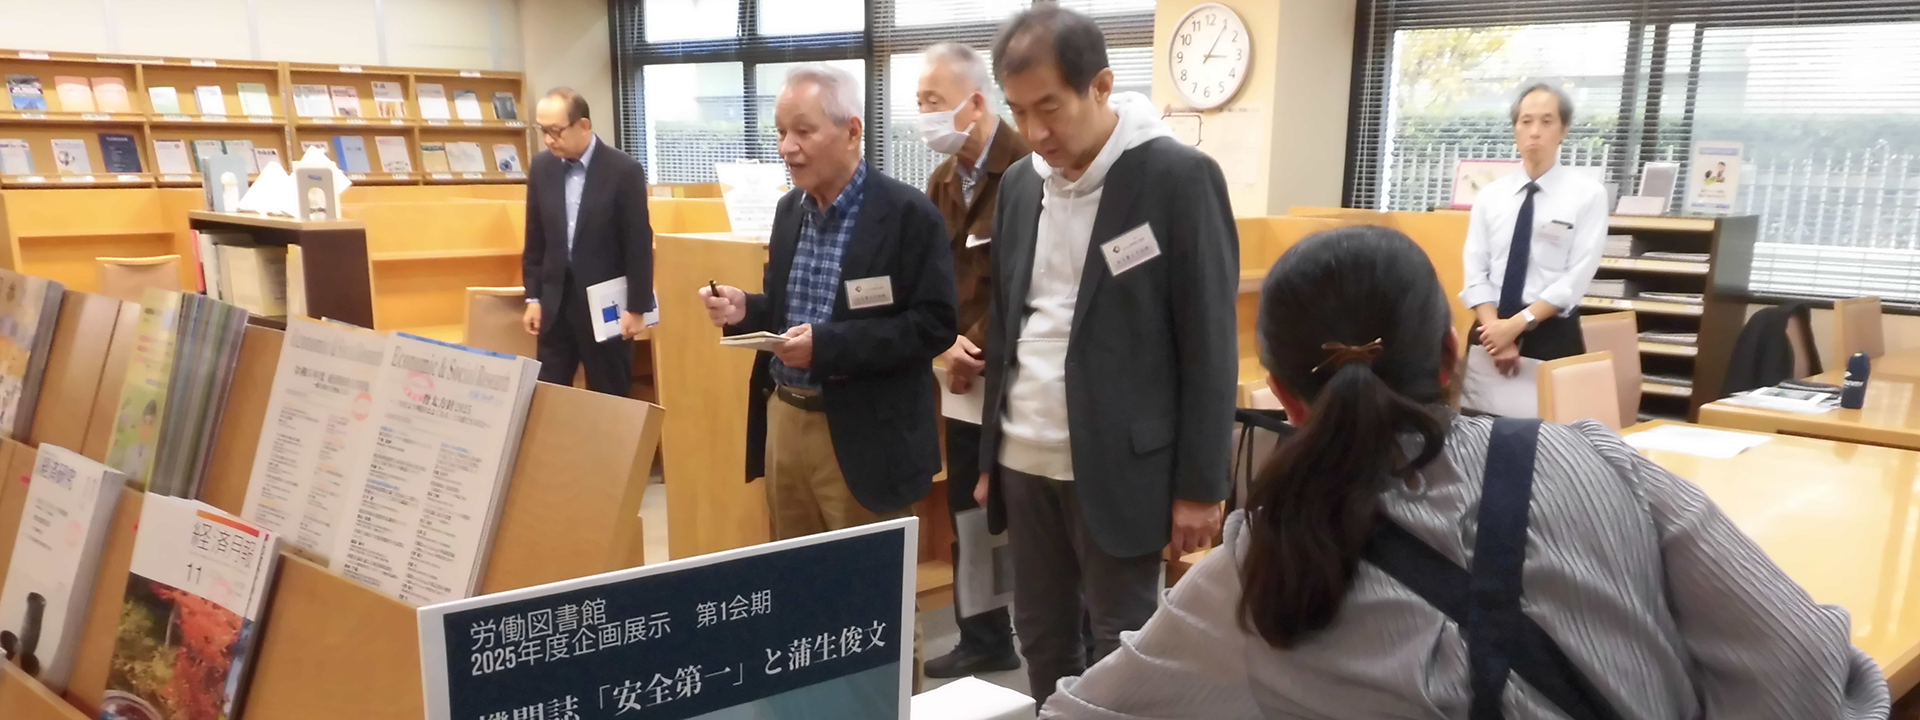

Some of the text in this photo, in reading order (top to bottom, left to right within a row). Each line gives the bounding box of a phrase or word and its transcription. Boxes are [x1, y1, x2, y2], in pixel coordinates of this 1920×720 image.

[1192, 20, 1201, 32] 11
[1205, 13, 1217, 26] 12
[1223, 18, 1228, 30] 1
[1180, 33, 1192, 46] 10
[1231, 30, 1239, 43] 2
[1176, 51, 1184, 64] 9
[1236, 48, 1243, 61] 3
[1180, 68, 1188, 82] 8
[1228, 66, 1236, 79] 4
[1191, 82, 1198, 94] 7
[1203, 86, 1211, 98] 6
[1218, 81, 1225, 94] 5
[391, 346, 438, 376] Economic
[438, 356, 448, 379] &
[187, 563, 202, 585] 11
[470, 598, 606, 650] 労働図書館
[471, 589, 771, 676] 2025年度企画展示 第1会期
[478, 620, 886, 720] 誌「安全第一」と蒲生俊文
